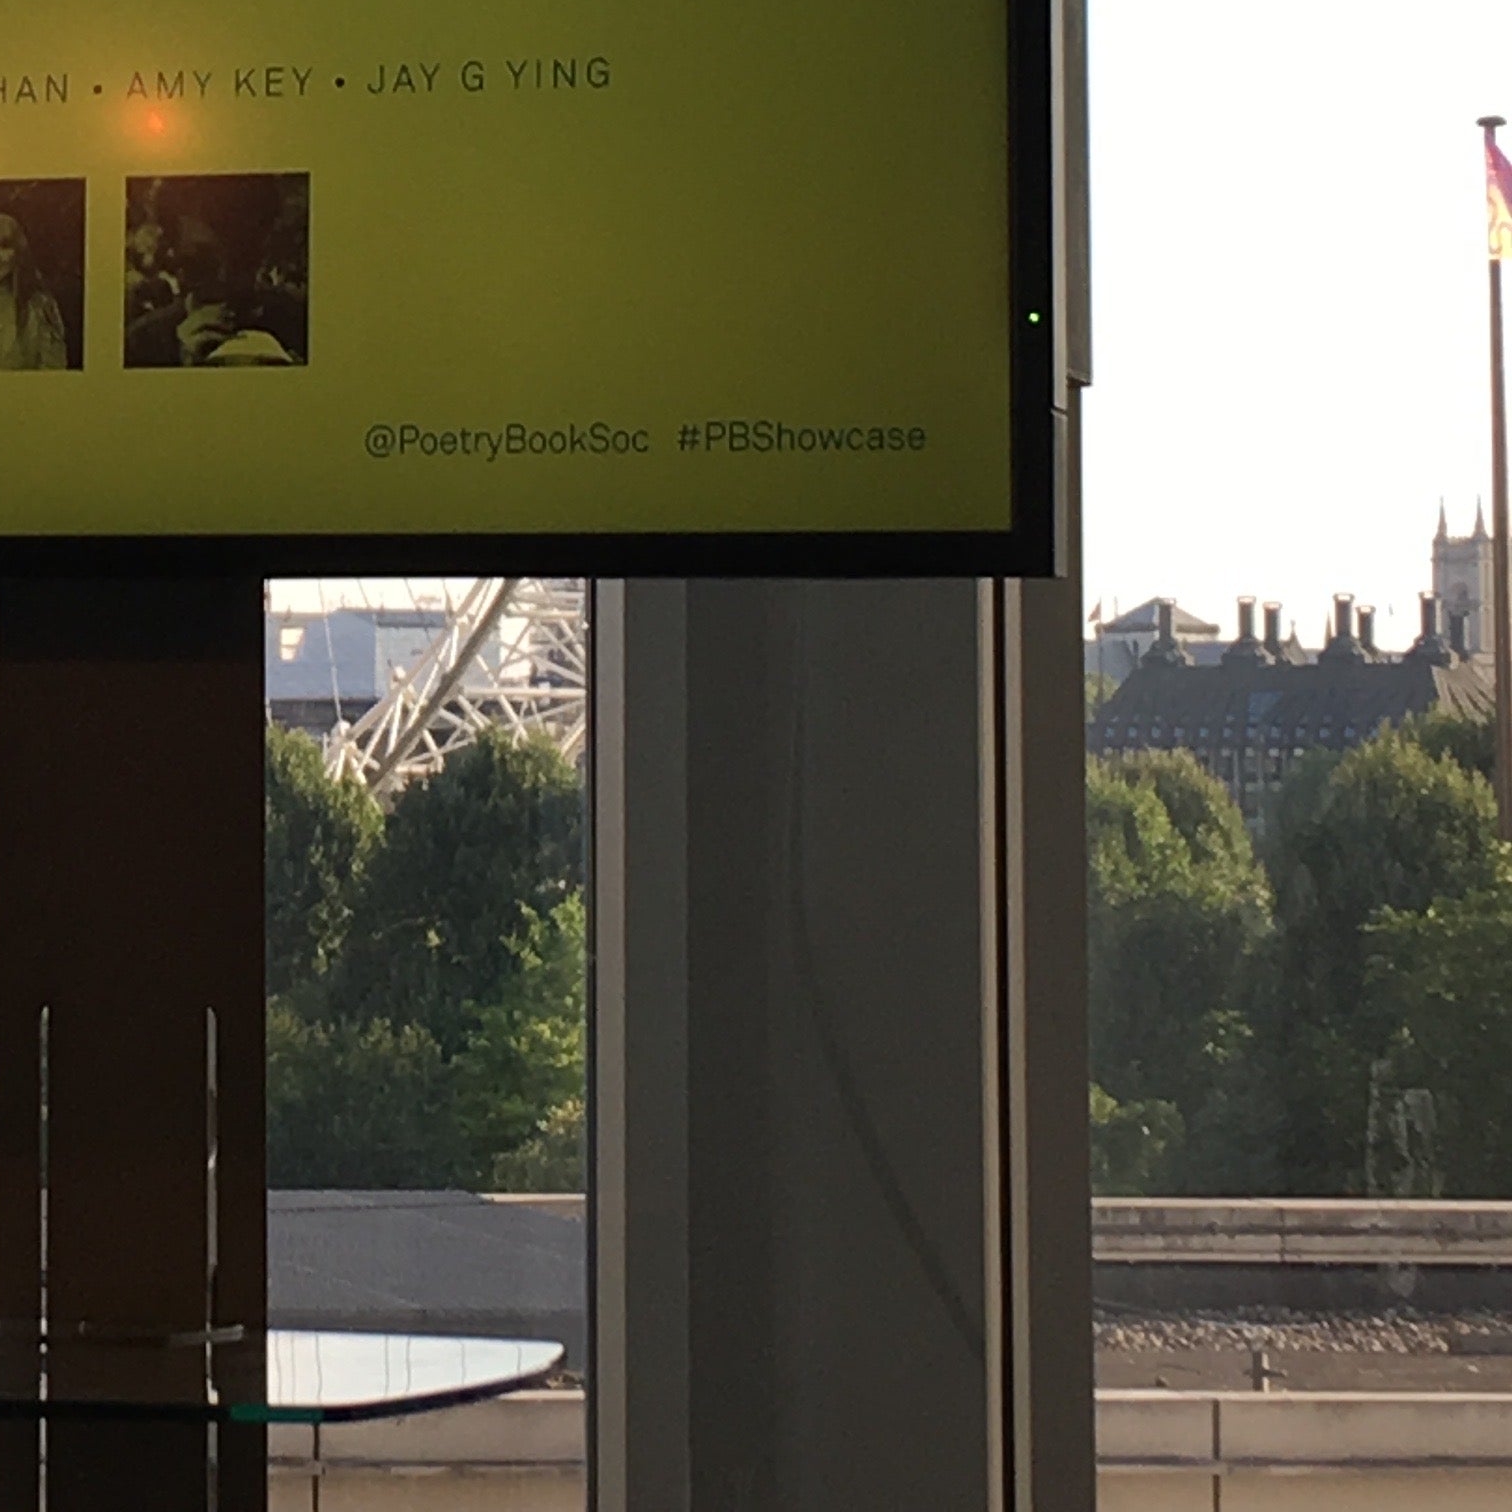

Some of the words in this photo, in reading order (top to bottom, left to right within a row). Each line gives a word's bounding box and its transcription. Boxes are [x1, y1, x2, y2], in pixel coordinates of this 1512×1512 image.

[126, 69, 213, 102] AMY
[234, 66, 313, 98] KEY
[367, 62, 441, 96] JAY
[460, 59, 485, 92] G
[506, 55, 611, 91] YING
[364, 422, 649, 463] @PoetryBookSoc
[677, 420, 926, 454] #PBShowcase
